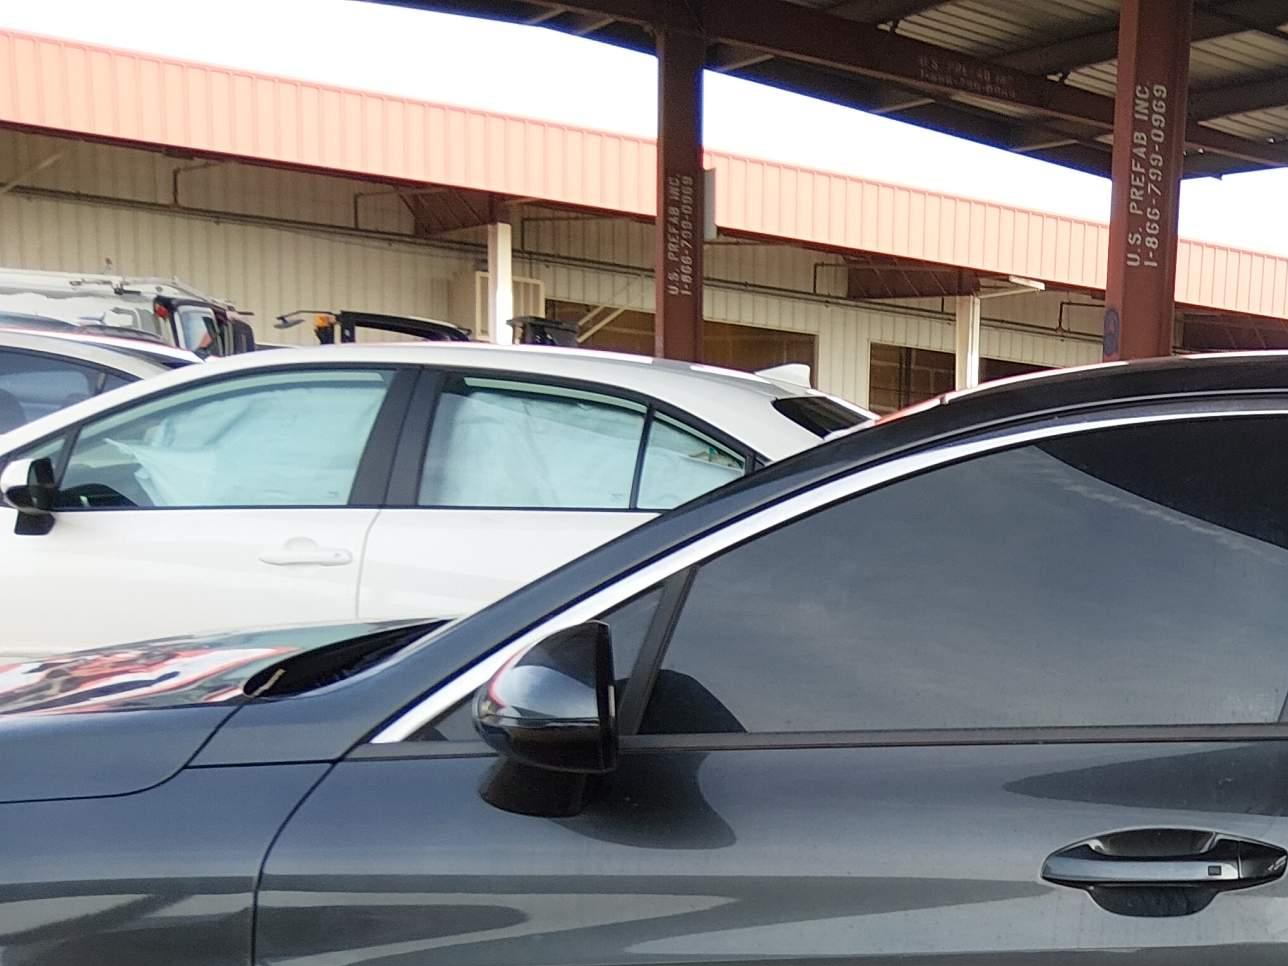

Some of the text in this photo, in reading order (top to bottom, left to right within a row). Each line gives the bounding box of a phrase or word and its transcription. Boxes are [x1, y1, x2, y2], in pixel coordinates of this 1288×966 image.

[1129, 131, 1148, 216] PREFAB
[1144, 84, 1167, 267] 1-866-799-0969
[1126, 227, 1143, 267] U.S.
